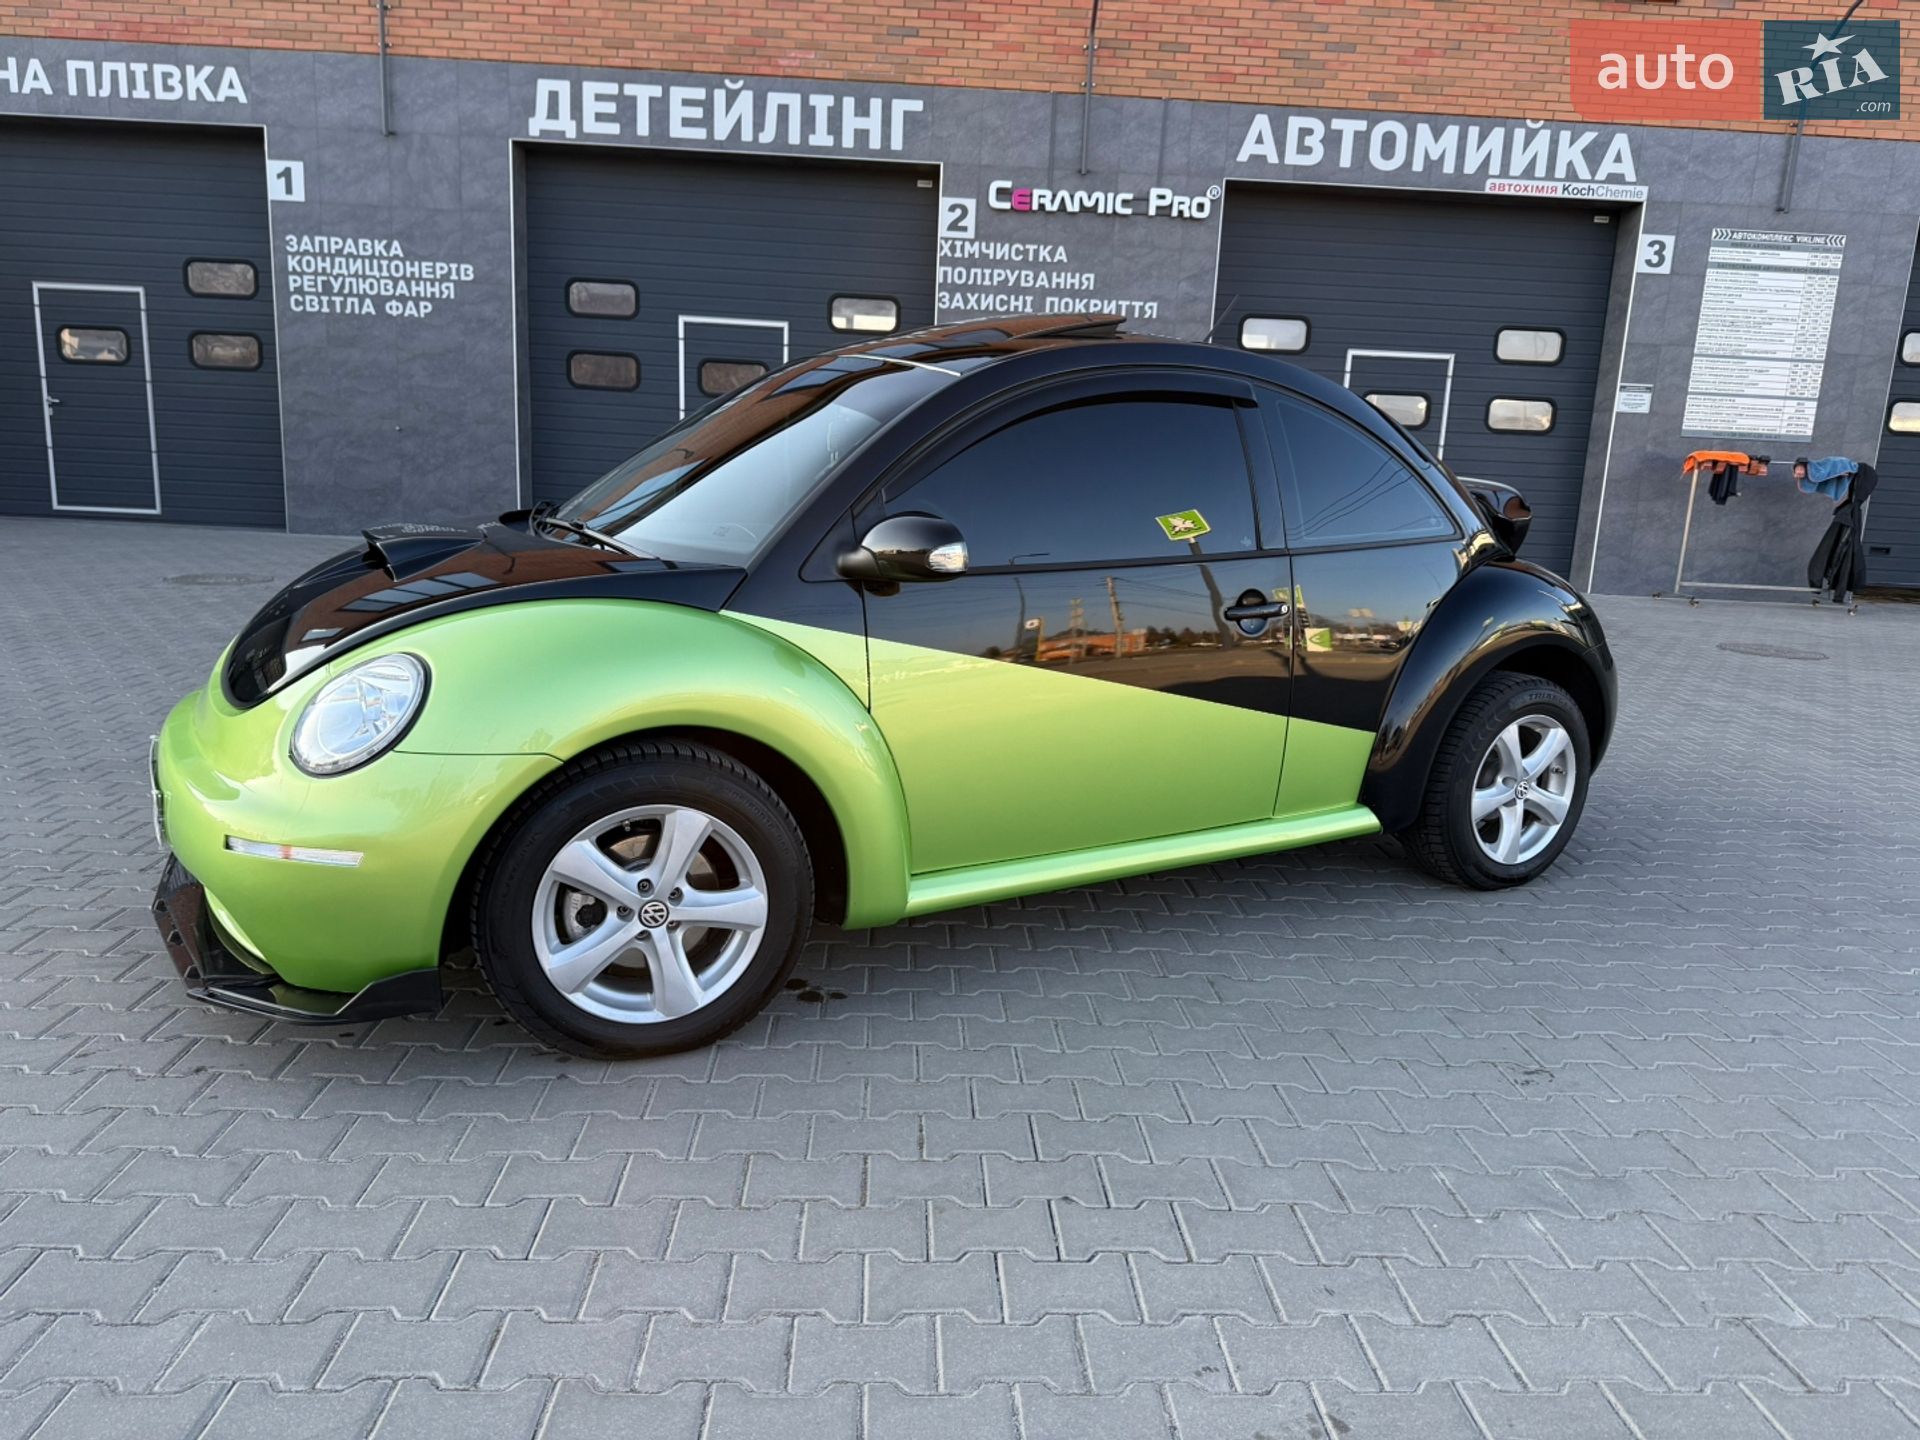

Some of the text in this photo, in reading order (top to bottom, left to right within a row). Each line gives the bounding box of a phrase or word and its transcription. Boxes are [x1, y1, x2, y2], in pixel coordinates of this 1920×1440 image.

[66, 59, 248, 104] ПЛІВКА
[528, 78, 924, 151] ДЕТЕЙЛІНГ
[1236, 112, 1637, 182] АВТОМИЙКА
[275, 166, 294, 196] 1
[1489, 182, 1558, 195] автохімія
[946, 203, 969, 232] 2
[285, 235, 404, 258] ЗАПРАВКА
[938, 239, 1068, 263] ХІМЧИСТКА
[1644, 240, 1667, 268] 3
[287, 254, 475, 281] КОНДИЦІОНЕРІВ
[938, 266, 1095, 290] ПОЛІРУВАННЯ
[288, 274, 455, 300] РЕГУЛЮВАННЯ
[289, 294, 433, 319] СВІТЛА ФАР
[938, 292, 1158, 319] ЗАХИСНІ ПОКРИТТЯ
